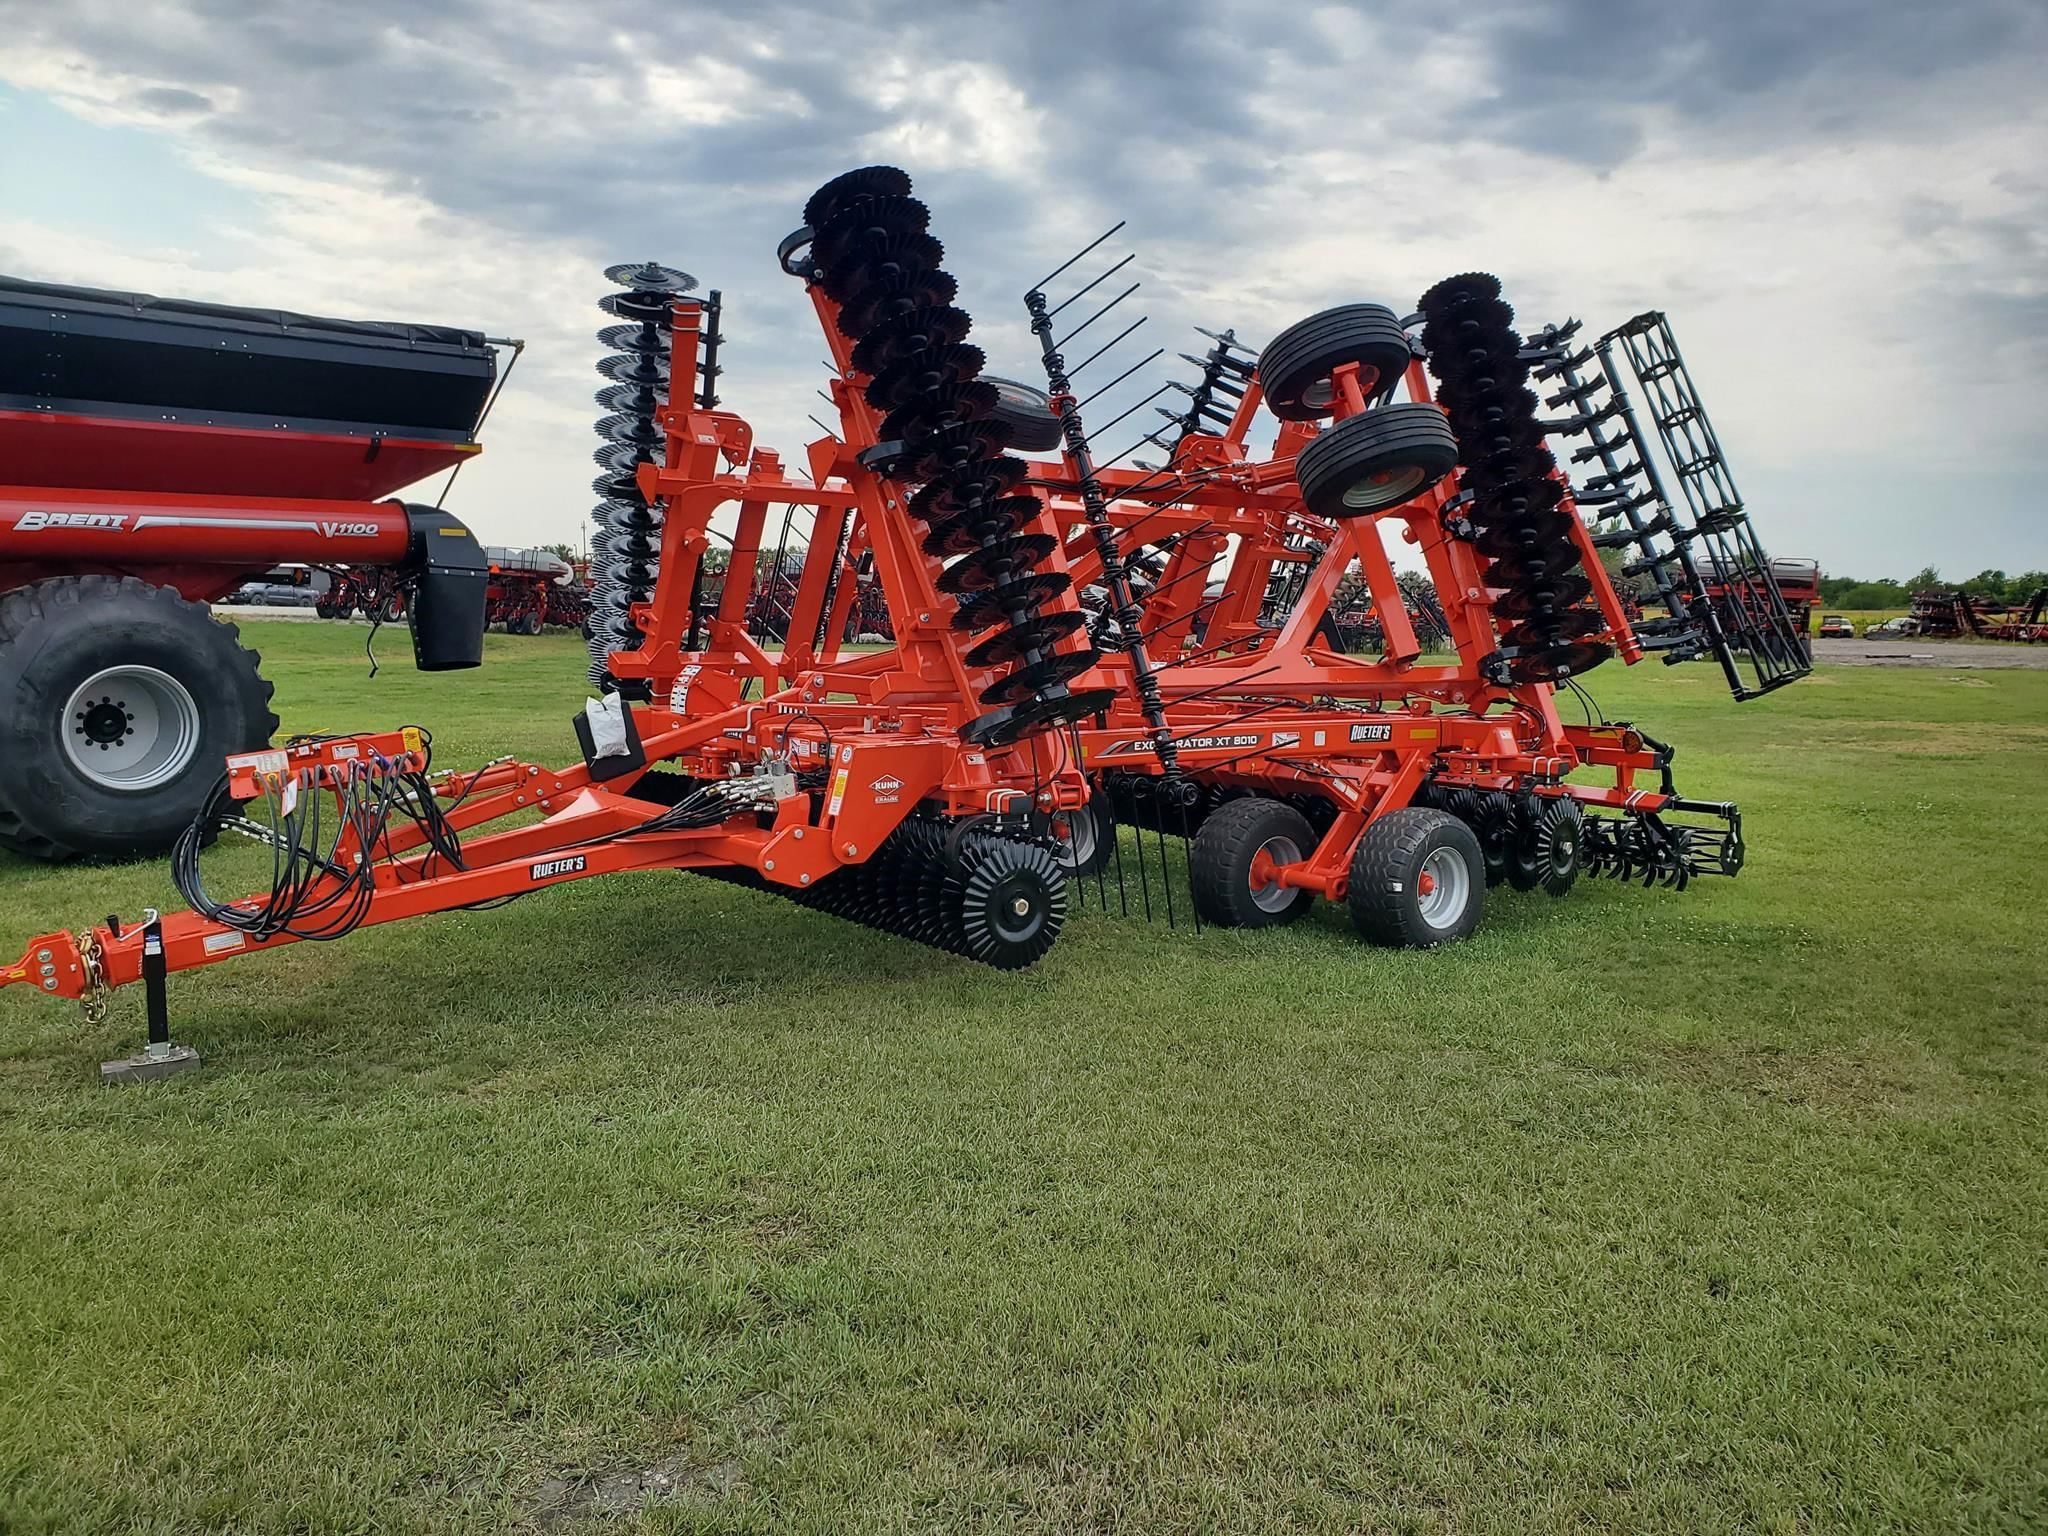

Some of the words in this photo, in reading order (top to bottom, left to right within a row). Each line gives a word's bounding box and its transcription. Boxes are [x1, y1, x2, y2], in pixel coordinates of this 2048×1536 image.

[13, 511, 129, 532] BRENT
[321, 521, 379, 539] V1100
[1350, 724, 1391, 742] RUETER'S
[1134, 737, 1210, 751] EXCRATOR
[1216, 736, 1231, 746] XT
[1233, 735, 1257, 745] 8010
[875, 781, 899, 790] KUHN
[532, 856, 585, 880] RUETER'S
